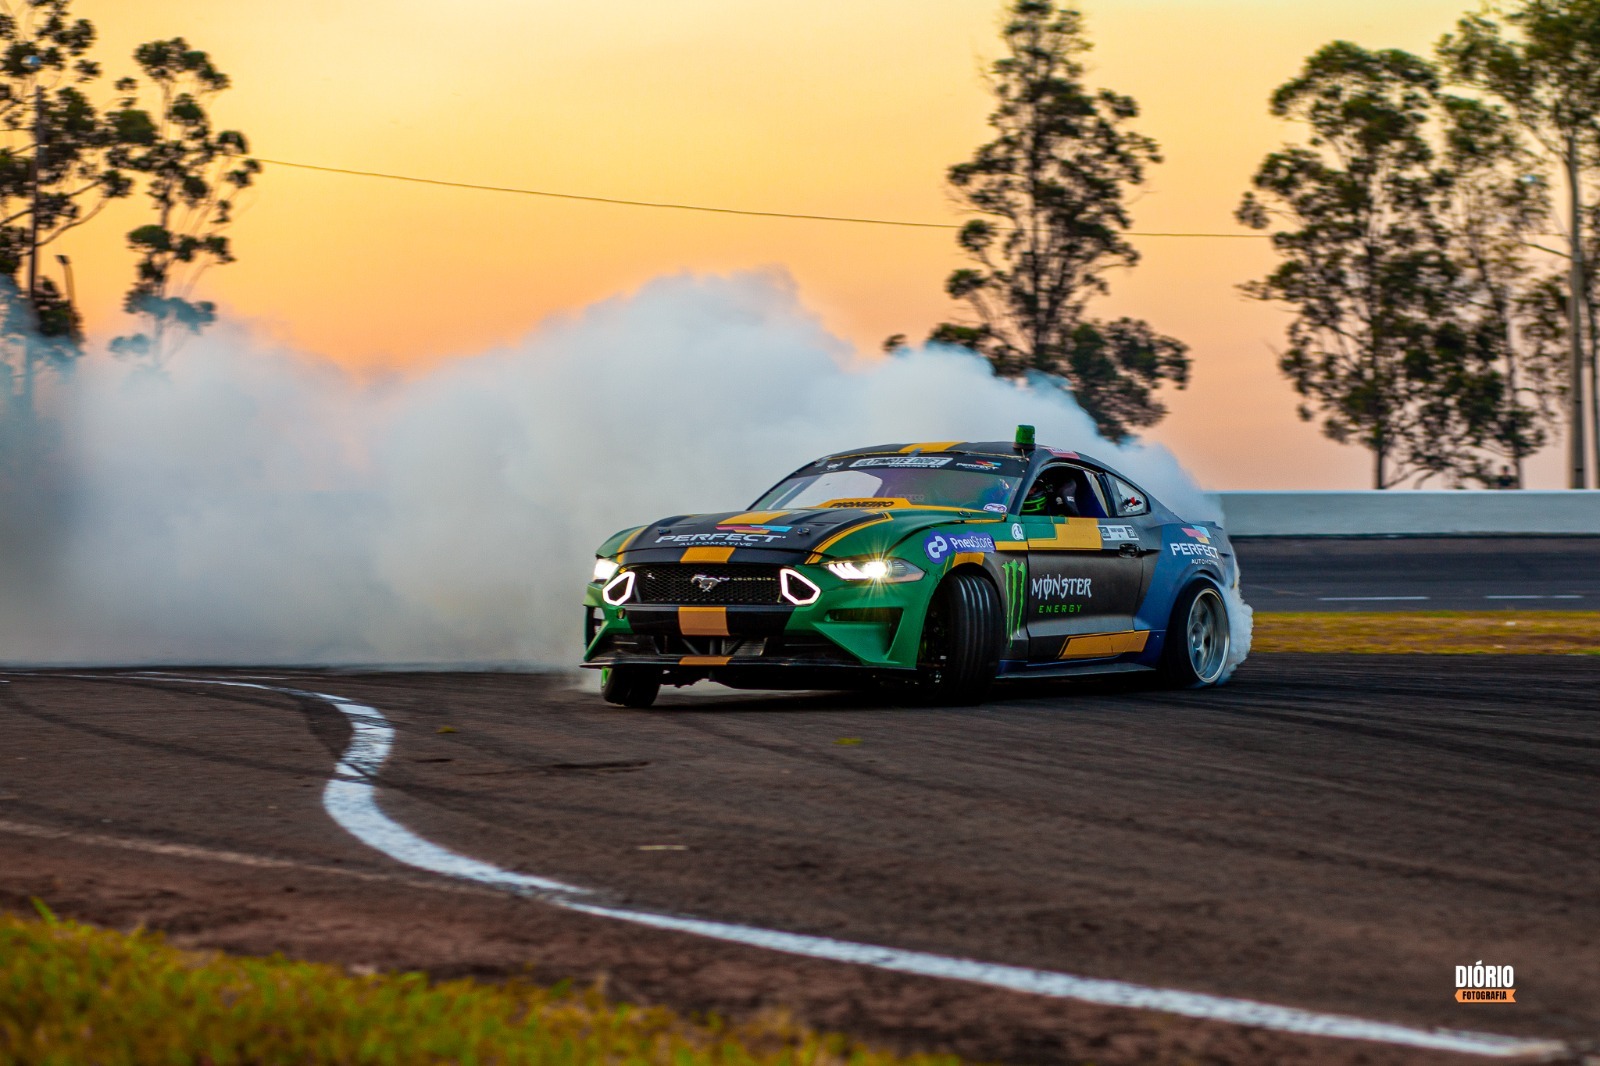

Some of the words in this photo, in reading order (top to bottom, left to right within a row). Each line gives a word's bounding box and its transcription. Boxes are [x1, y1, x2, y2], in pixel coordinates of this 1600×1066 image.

[655, 533, 782, 543] PERFECT
[950, 535, 994, 549] PneuStore
[1170, 543, 1219, 559] PERFECT
[1191, 559, 1218, 567] AUTOMO
[1031, 573, 1092, 600] MONSTER
[1039, 604, 1082, 613] ENERGY
